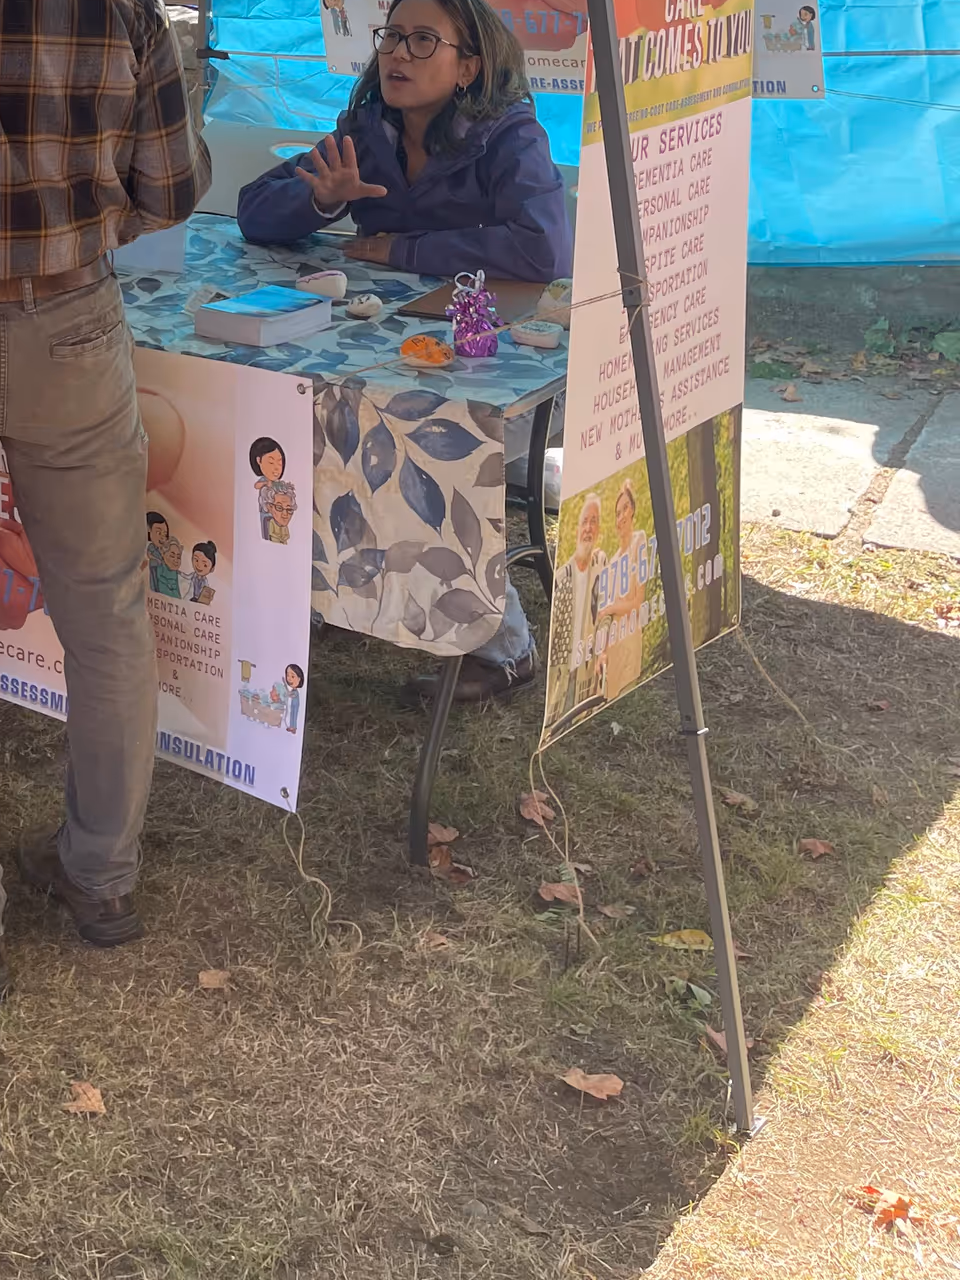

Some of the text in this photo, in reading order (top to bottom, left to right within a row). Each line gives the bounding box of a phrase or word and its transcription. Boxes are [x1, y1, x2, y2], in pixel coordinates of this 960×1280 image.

[643, 22, 703, 81] COMES
[707, 17, 725, 64] TO
[728, 9, 753, 58] YOU
[631, 111, 723, 163] UR SERVICES
[690, 147, 713, 172] CARE
[638, 176, 711, 219] ERSONAL CARE
[642, 204, 709, 246] MPANIONSHIP
[644, 233, 704, 274] SPITE CARE
[648, 259, 708, 303] SPORTATION
[683, 286, 707, 312] CARE
[674, 306, 720, 347] SERVICES
[593, 332, 721, 415] HOUSEH MANAGEMENT
[580, 422, 603, 451] NEW
[670, 355, 730, 403] ASSISTANCE
[615, 441, 622, 461] &
[147, 597, 221, 628] MENTIA CARE
[149, 613, 221, 645] SONAL CARE
[155, 631, 221, 659] PANIONSHIP
[157, 649, 224, 679] SPORTATION
[172, 669, 178, 680] &
[156, 731, 255, 786] NSULATION
